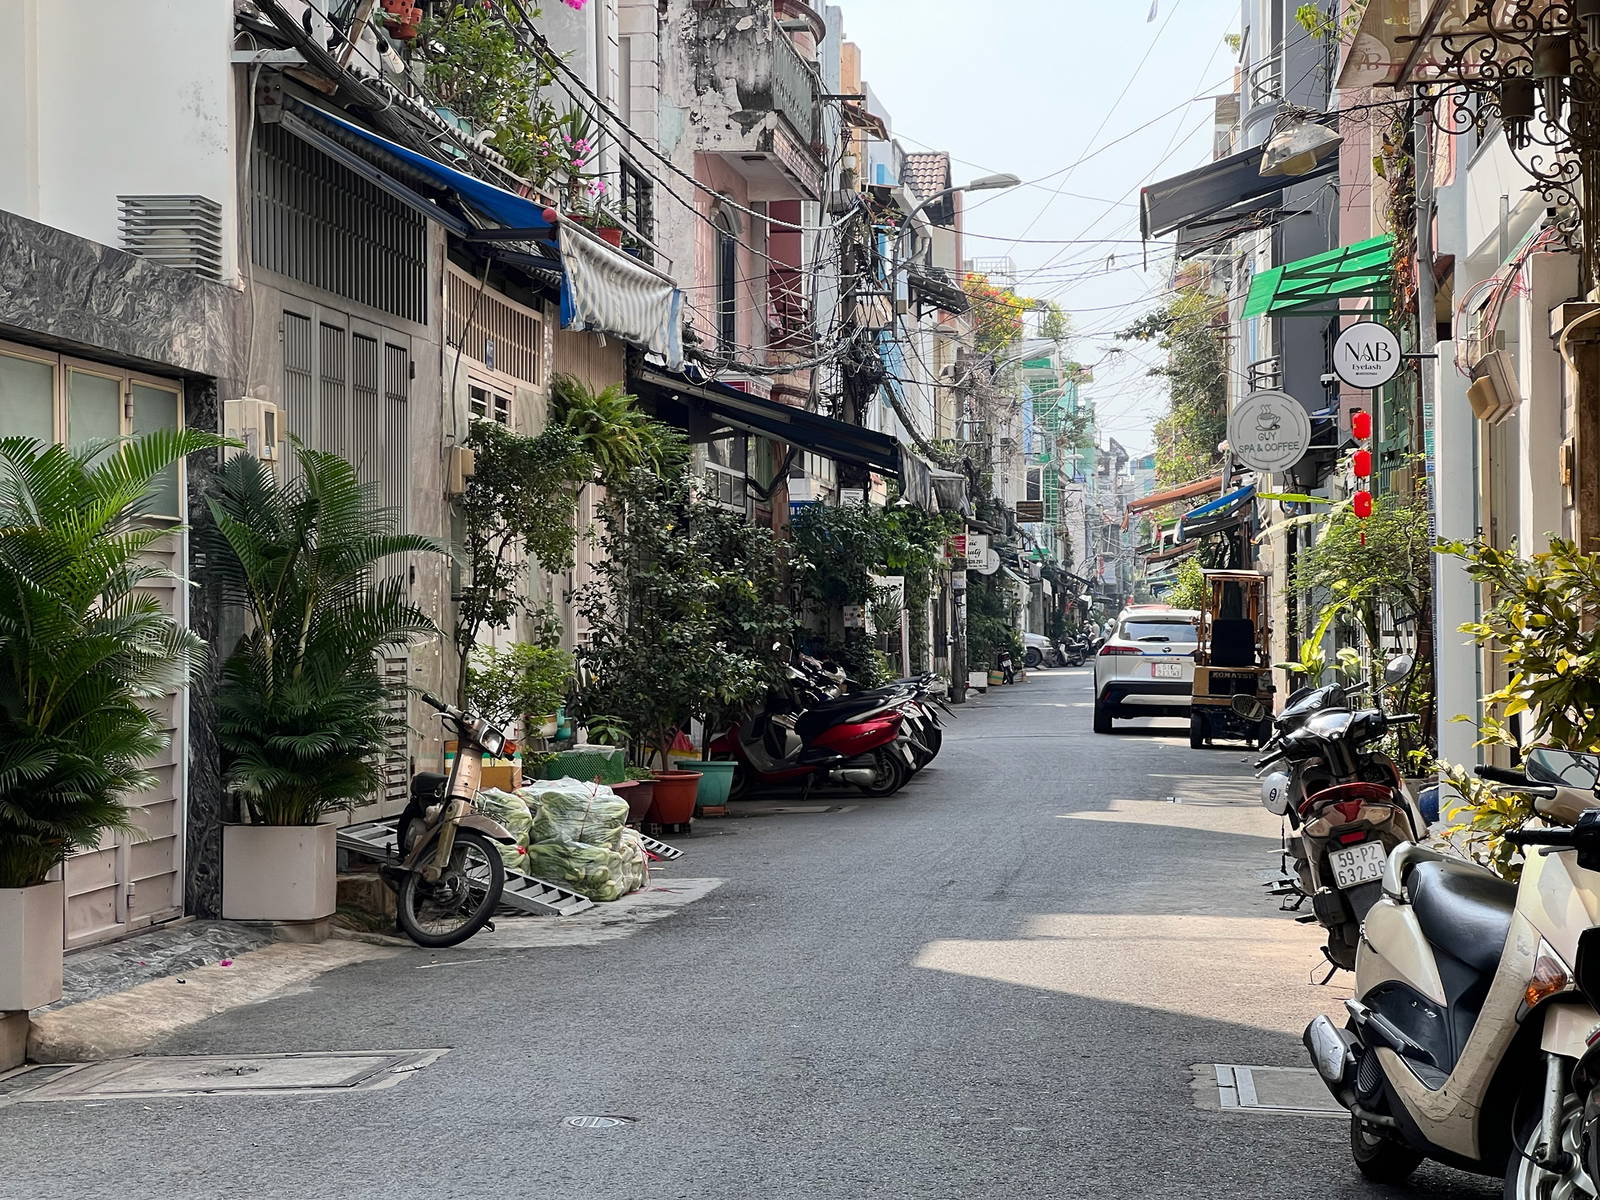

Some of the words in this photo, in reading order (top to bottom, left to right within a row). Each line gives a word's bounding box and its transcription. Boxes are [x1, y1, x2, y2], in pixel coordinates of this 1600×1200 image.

[1344, 341, 1392, 362] NAB
[1257, 432, 1276, 442] GUY
[1239, 444, 1255, 454] SPA
[1257, 443, 1263, 452] &
[1265, 442, 1299, 451] COFFEE
